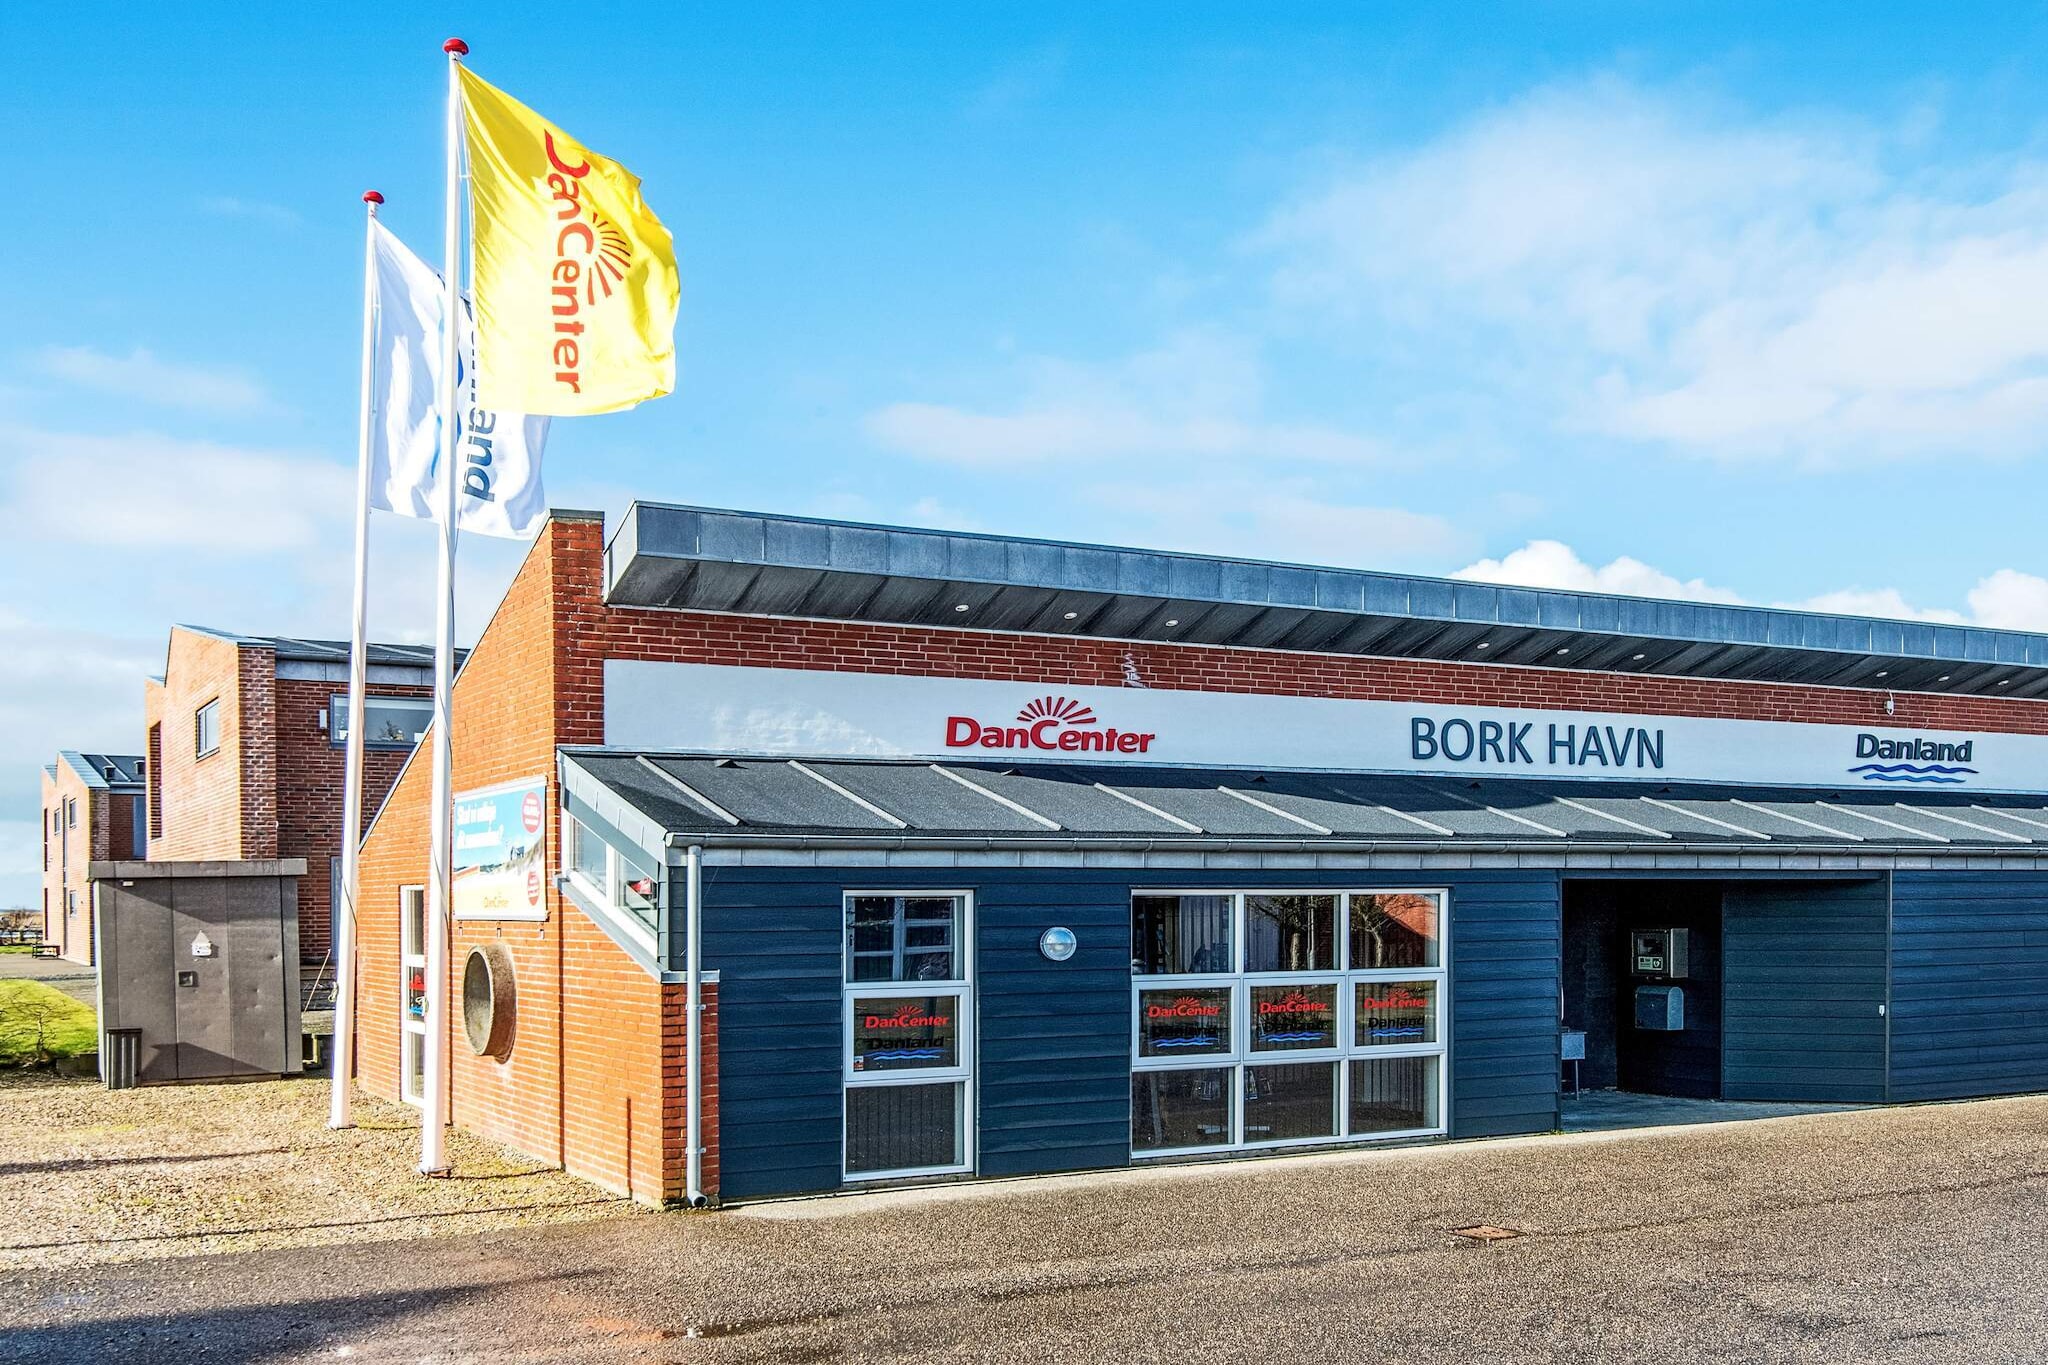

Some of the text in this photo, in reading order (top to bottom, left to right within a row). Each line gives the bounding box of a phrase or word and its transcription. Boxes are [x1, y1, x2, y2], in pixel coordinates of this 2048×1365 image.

[945, 716, 1156, 753] DanCenter
[1411, 717, 1664, 769] BORK HAVN
[1855, 733, 1974, 762] Danland
[1259, 1001, 1329, 1015] DanCenter
[1364, 997, 1429, 1010] DanCenter
[1148, 1004, 1221, 1018] DanCenter
[864, 1014, 950, 1029] DanCenter
[1368, 1017, 1425, 1029] Danland
[867, 1036, 945, 1049] Danland
